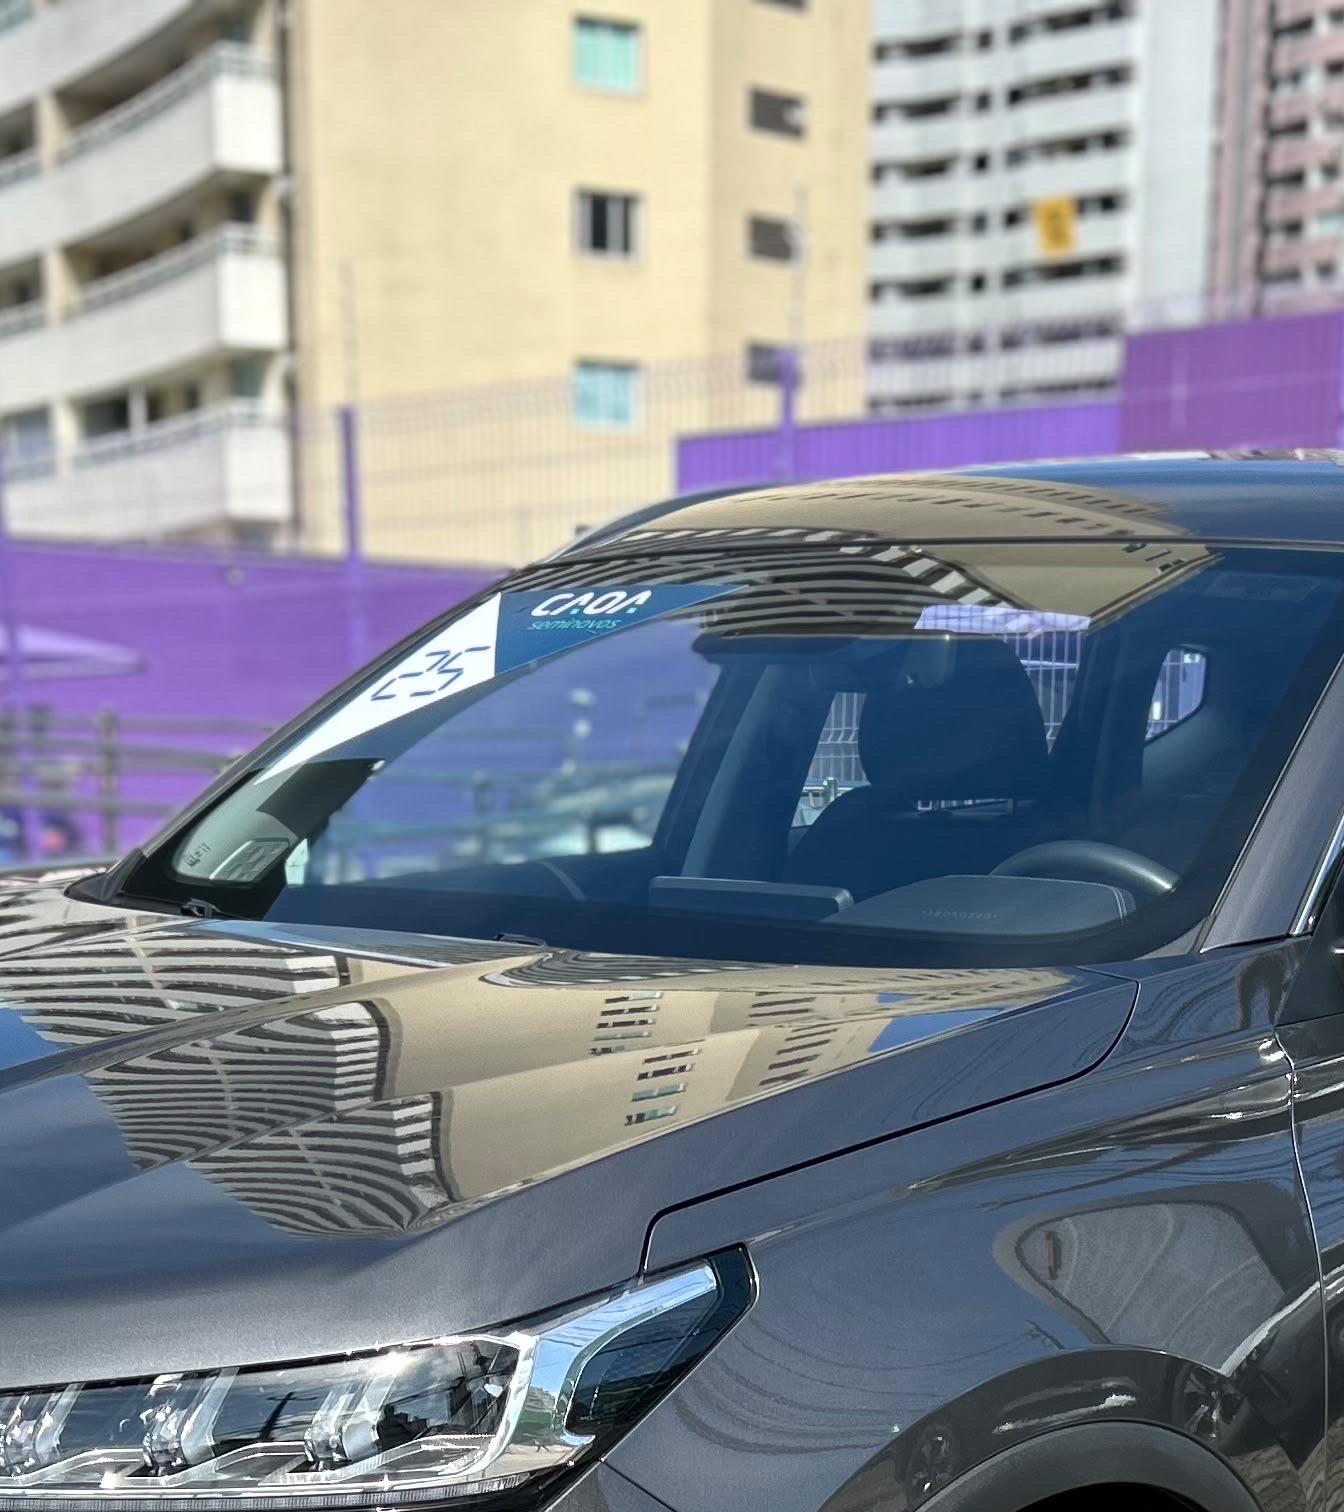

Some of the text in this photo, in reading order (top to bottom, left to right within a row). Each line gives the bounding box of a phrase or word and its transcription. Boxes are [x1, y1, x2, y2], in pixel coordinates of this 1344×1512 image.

[530, 589, 653, 617] CAOA
[526, 616, 623, 631] seminovos
[369, 645, 492, 701] 25
